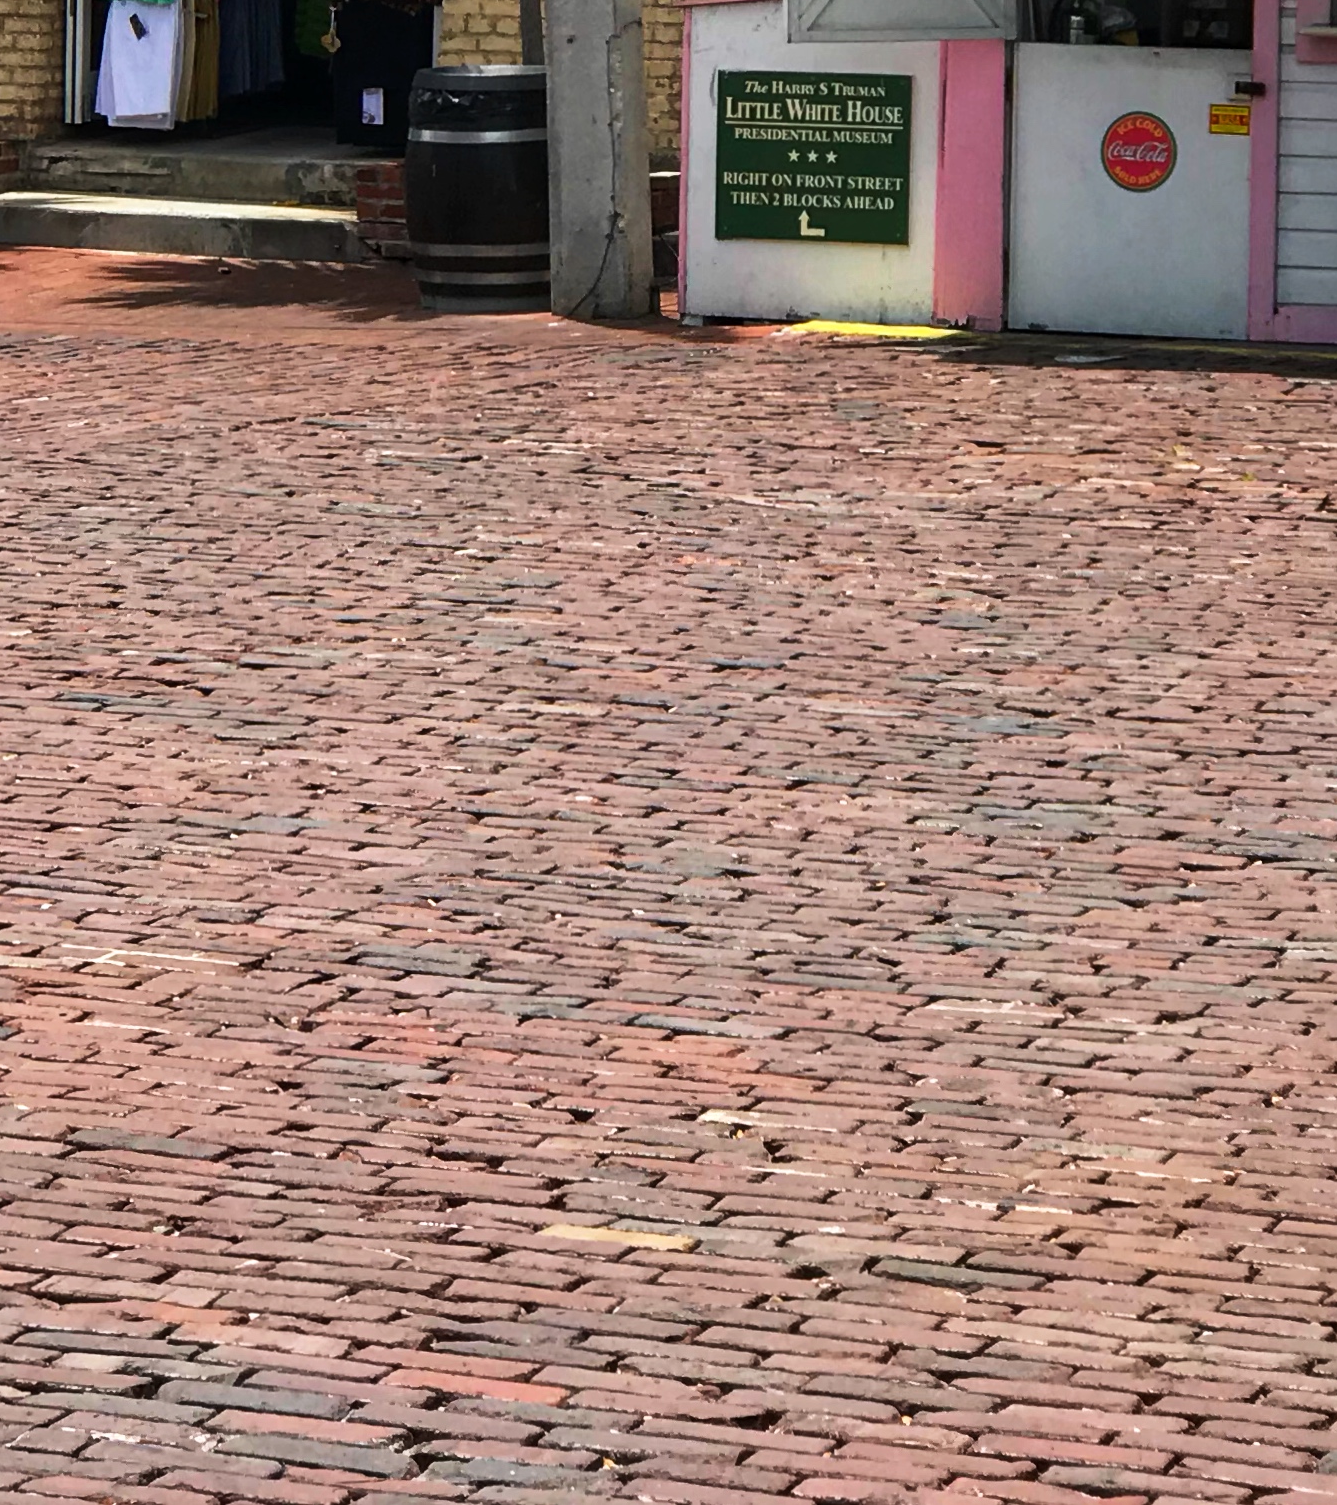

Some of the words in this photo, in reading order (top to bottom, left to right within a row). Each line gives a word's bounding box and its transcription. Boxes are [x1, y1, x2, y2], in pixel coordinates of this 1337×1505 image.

[745, 81, 768, 93] The
[819, 83, 828, 95] S
[734, 127, 830, 142] PRESIDENTIAL
[833, 131, 893, 144] MUSEUM
[1117, 120, 1134, 135] ICE
[1136, 118, 1163, 138] COLD
[723, 172, 769, 185] RIGHT
[772, 173, 792, 187] ON
[796, 174, 845, 189] FRONT
[847, 176, 904, 191] STREET
[1113, 166, 1137, 184] SOLD
[1137, 169, 1162, 185] HERE
[730, 191, 770, 206] THEN
[773, 193, 780, 206] 2
[783, 194, 841, 208] BLOCKS
[844, 196, 894, 210] AHEAD
